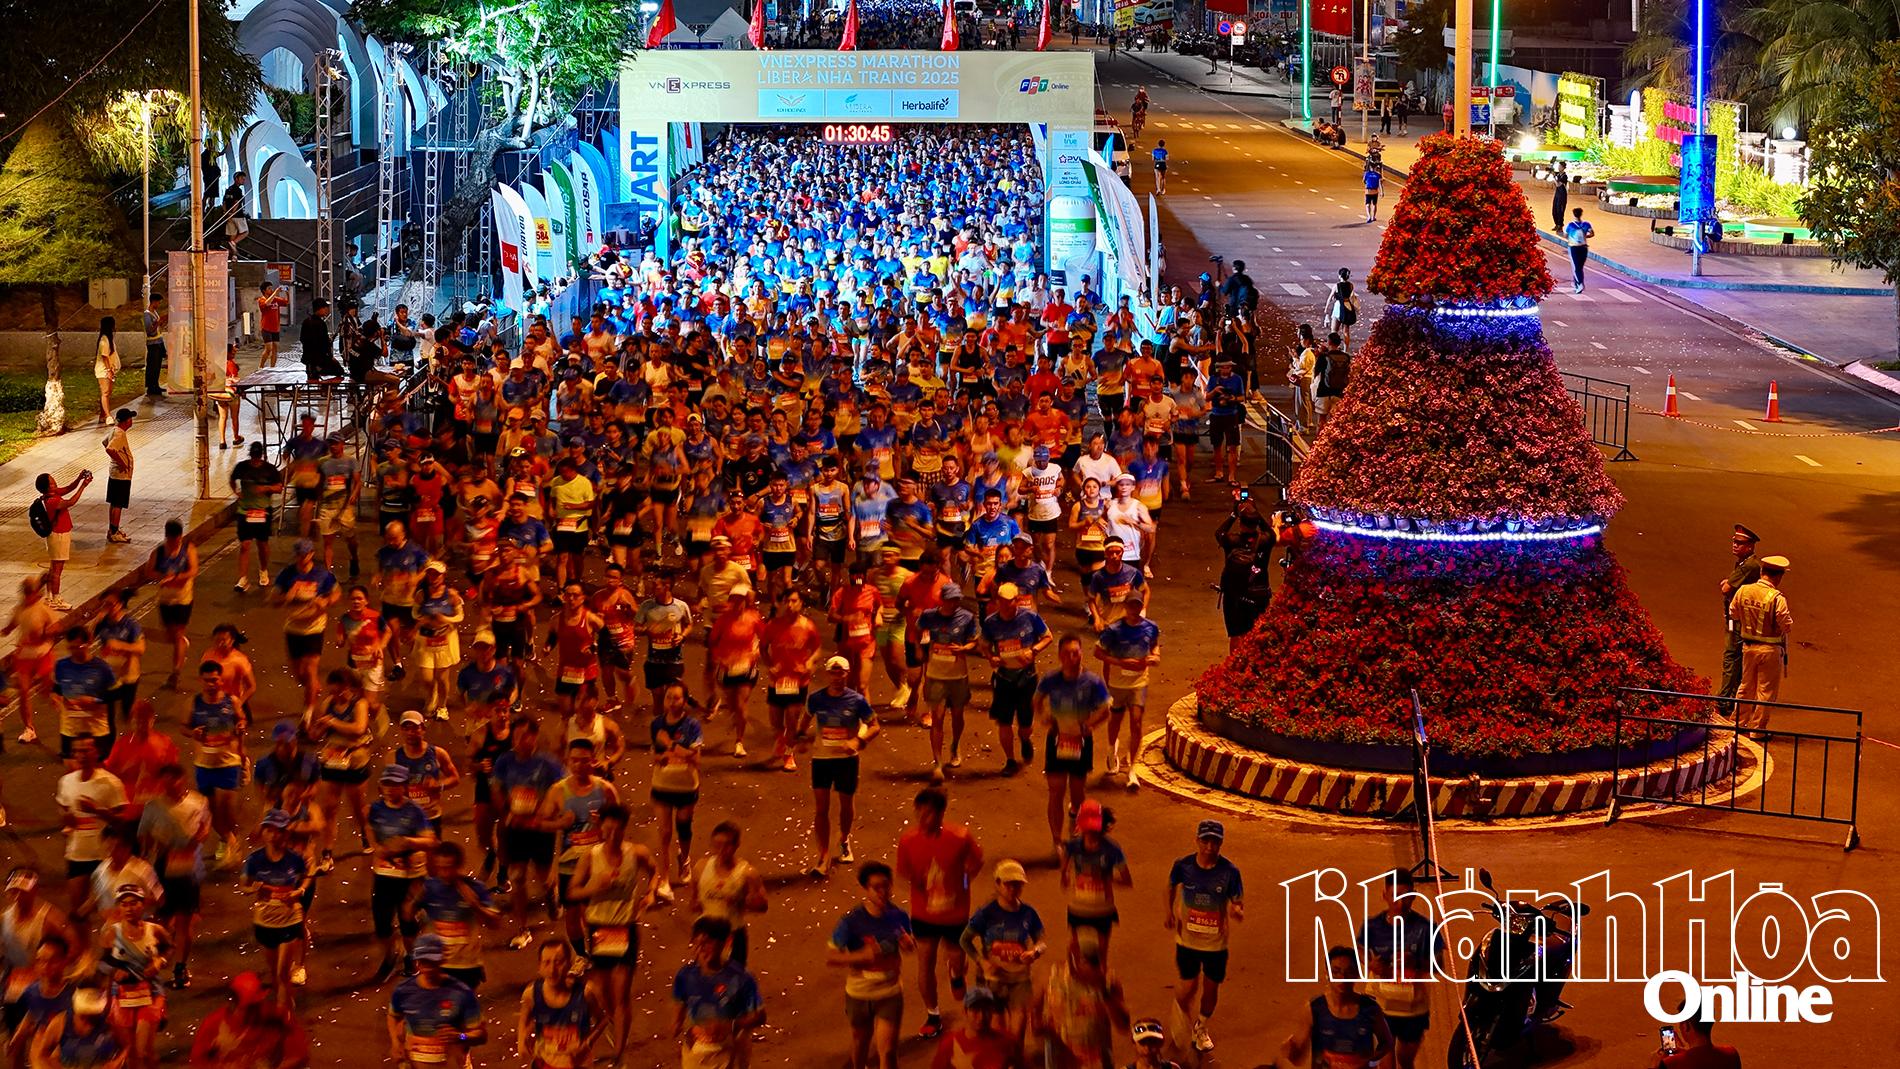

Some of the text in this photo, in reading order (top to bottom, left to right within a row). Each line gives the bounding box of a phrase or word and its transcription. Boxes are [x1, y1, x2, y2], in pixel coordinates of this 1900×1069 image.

[758, 55, 960, 69] VNEXPRESS MARATHON
[758, 71, 960, 85] LIBERA NHA TRANG 2025
[1020, 76, 1070, 95] FPT Online
[902, 98, 946, 111] Herbalife
[824, 125, 890, 142] 01:30:45
[535, 231, 550, 241] 584
